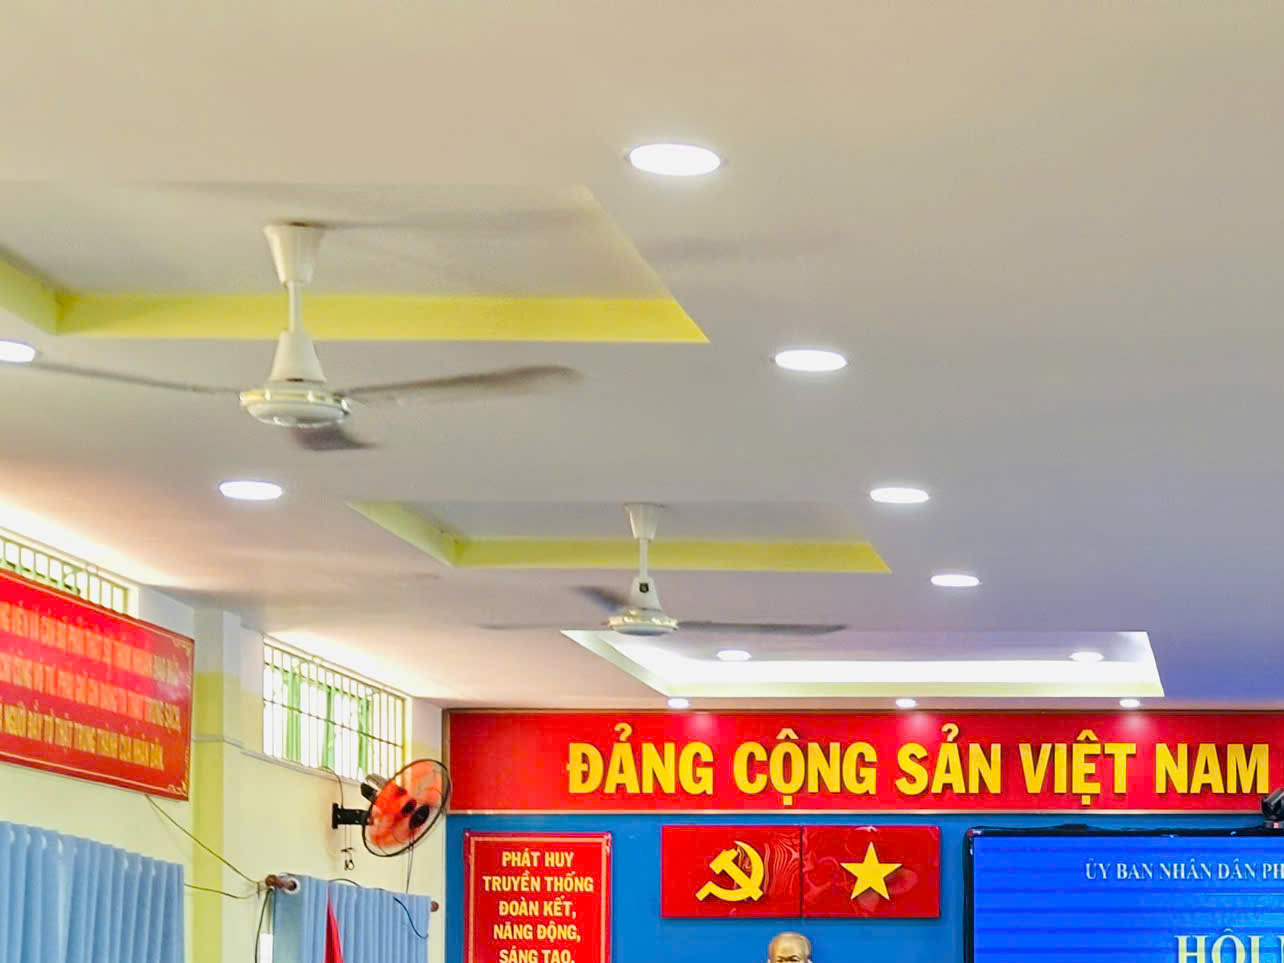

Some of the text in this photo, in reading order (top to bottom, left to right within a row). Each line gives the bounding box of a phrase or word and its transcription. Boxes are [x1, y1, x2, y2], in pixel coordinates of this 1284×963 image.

[567, 722, 714, 794] ĐẢNG
[733, 728, 878, 805] CỘNG
[895, 722, 1001, 795] SẢN
[1018, 729, 1136, 805] VIỆT
[1156, 743, 1269, 794] NAM
[502, 848, 574, 867] PHÁT HUY
[1116, 863, 1153, 880] BAN
[1159, 858, 1213, 880] NHÂN
[1217, 858, 1256, 880] DÂN
[482, 870, 594, 892] TRUYỀN THỐNG
[499, 896, 576, 919] ĐOÀN KẾT,
[493, 921, 581, 942] NĂNG ĐỘNG,
